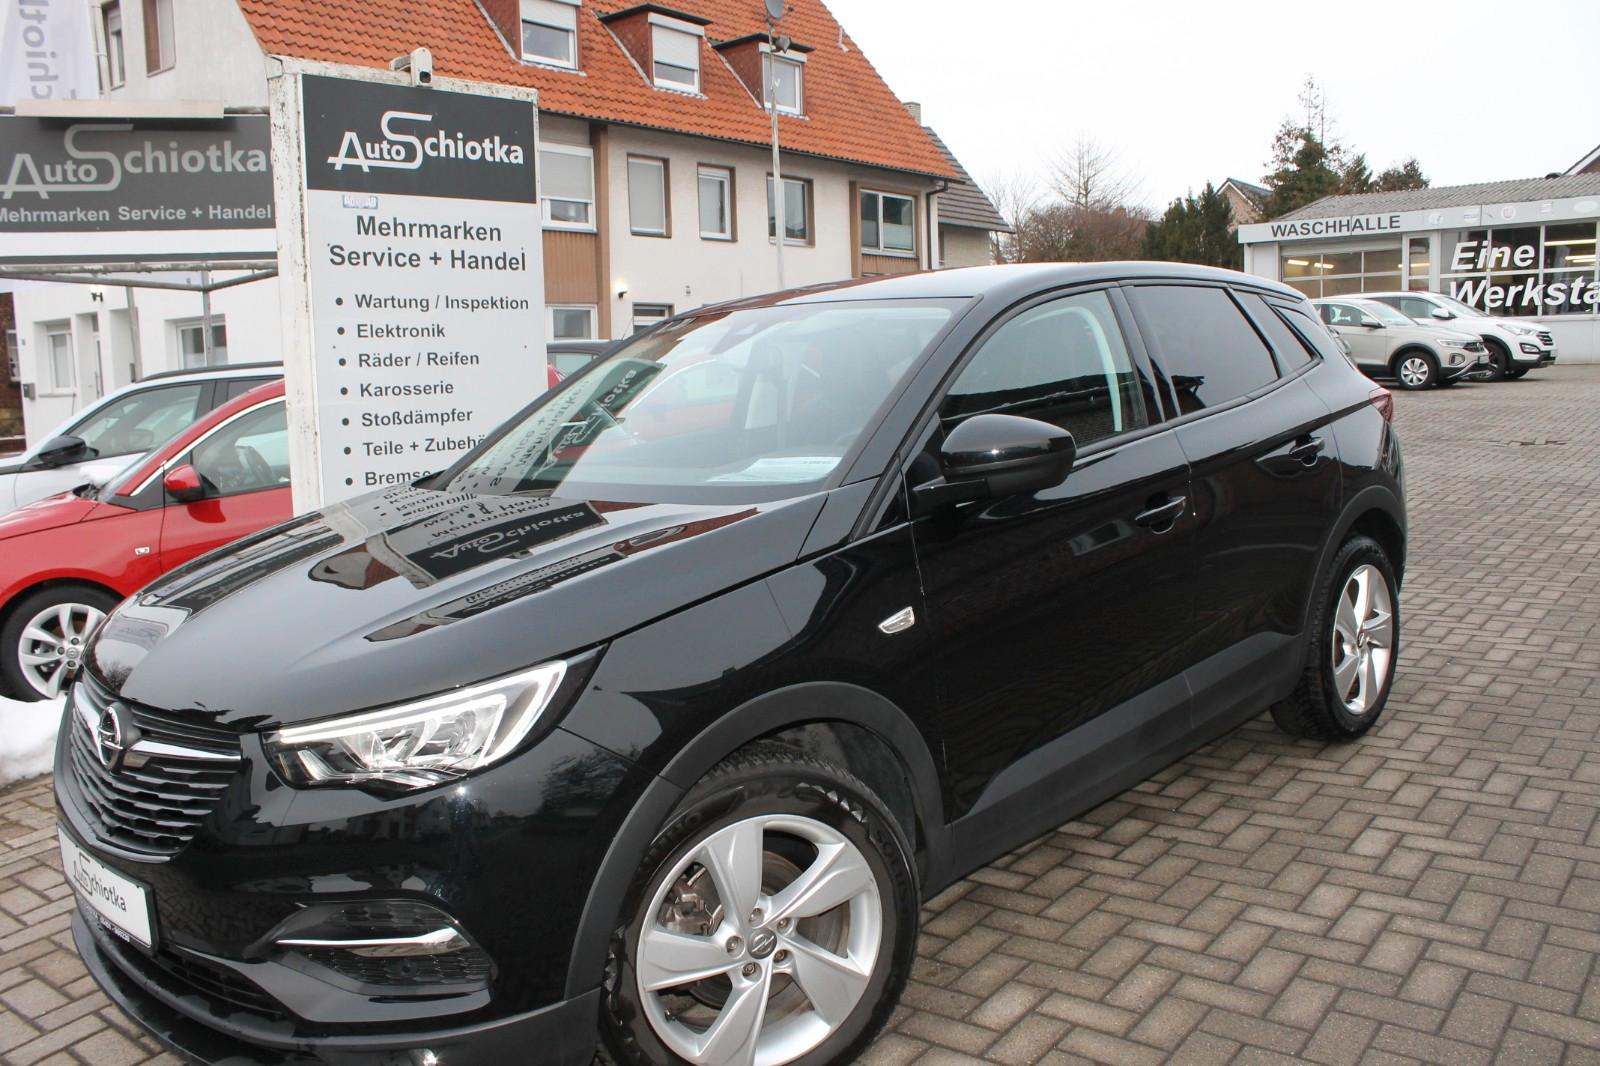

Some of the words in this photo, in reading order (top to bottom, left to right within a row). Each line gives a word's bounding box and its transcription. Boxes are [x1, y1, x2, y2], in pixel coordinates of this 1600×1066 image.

[118, 205, 187, 221] Service
[191, 208, 203, 219] +
[208, 204, 272, 220] Handel
[356, 215, 502, 242] Mehrmarken
[1271, 215, 1401, 238] WASCHHALLE
[329, 244, 421, 268] Service
[429, 251, 442, 266] +
[450, 248, 526, 271] Handel
[1451, 240, 1535, 271] Eine
[355, 294, 430, 312] Wartung
[445, 295, 530, 312] Inspektion
[357, 323, 446, 338] Elektronik
[358, 353, 412, 368] Räder
[427, 352, 480, 367] Reifen
[360, 381, 454, 398] Karosserie
[361, 409, 473, 427] Stoßdämpfer
[363, 441, 404, 456] Teile
[409, 442, 420, 453] +
